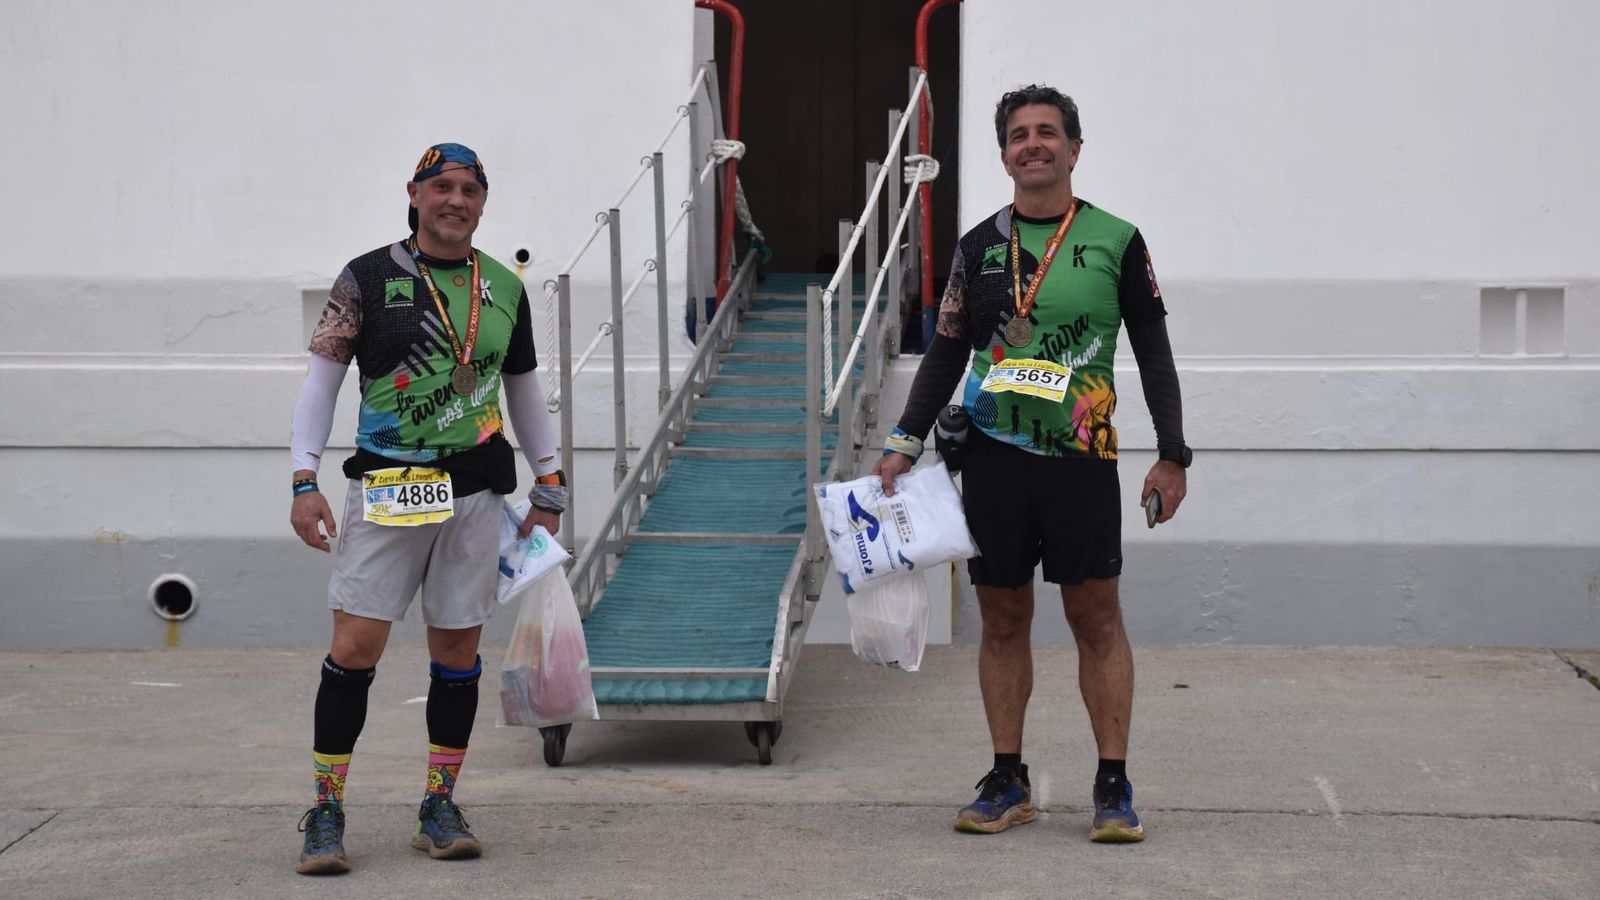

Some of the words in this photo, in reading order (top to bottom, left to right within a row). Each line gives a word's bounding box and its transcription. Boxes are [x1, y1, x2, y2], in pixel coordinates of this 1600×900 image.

[1073, 244, 1087, 268] K
[1015, 369, 1066, 386] 5657
[437, 398, 464, 431] nos
[397, 483, 449, 507] 4886
